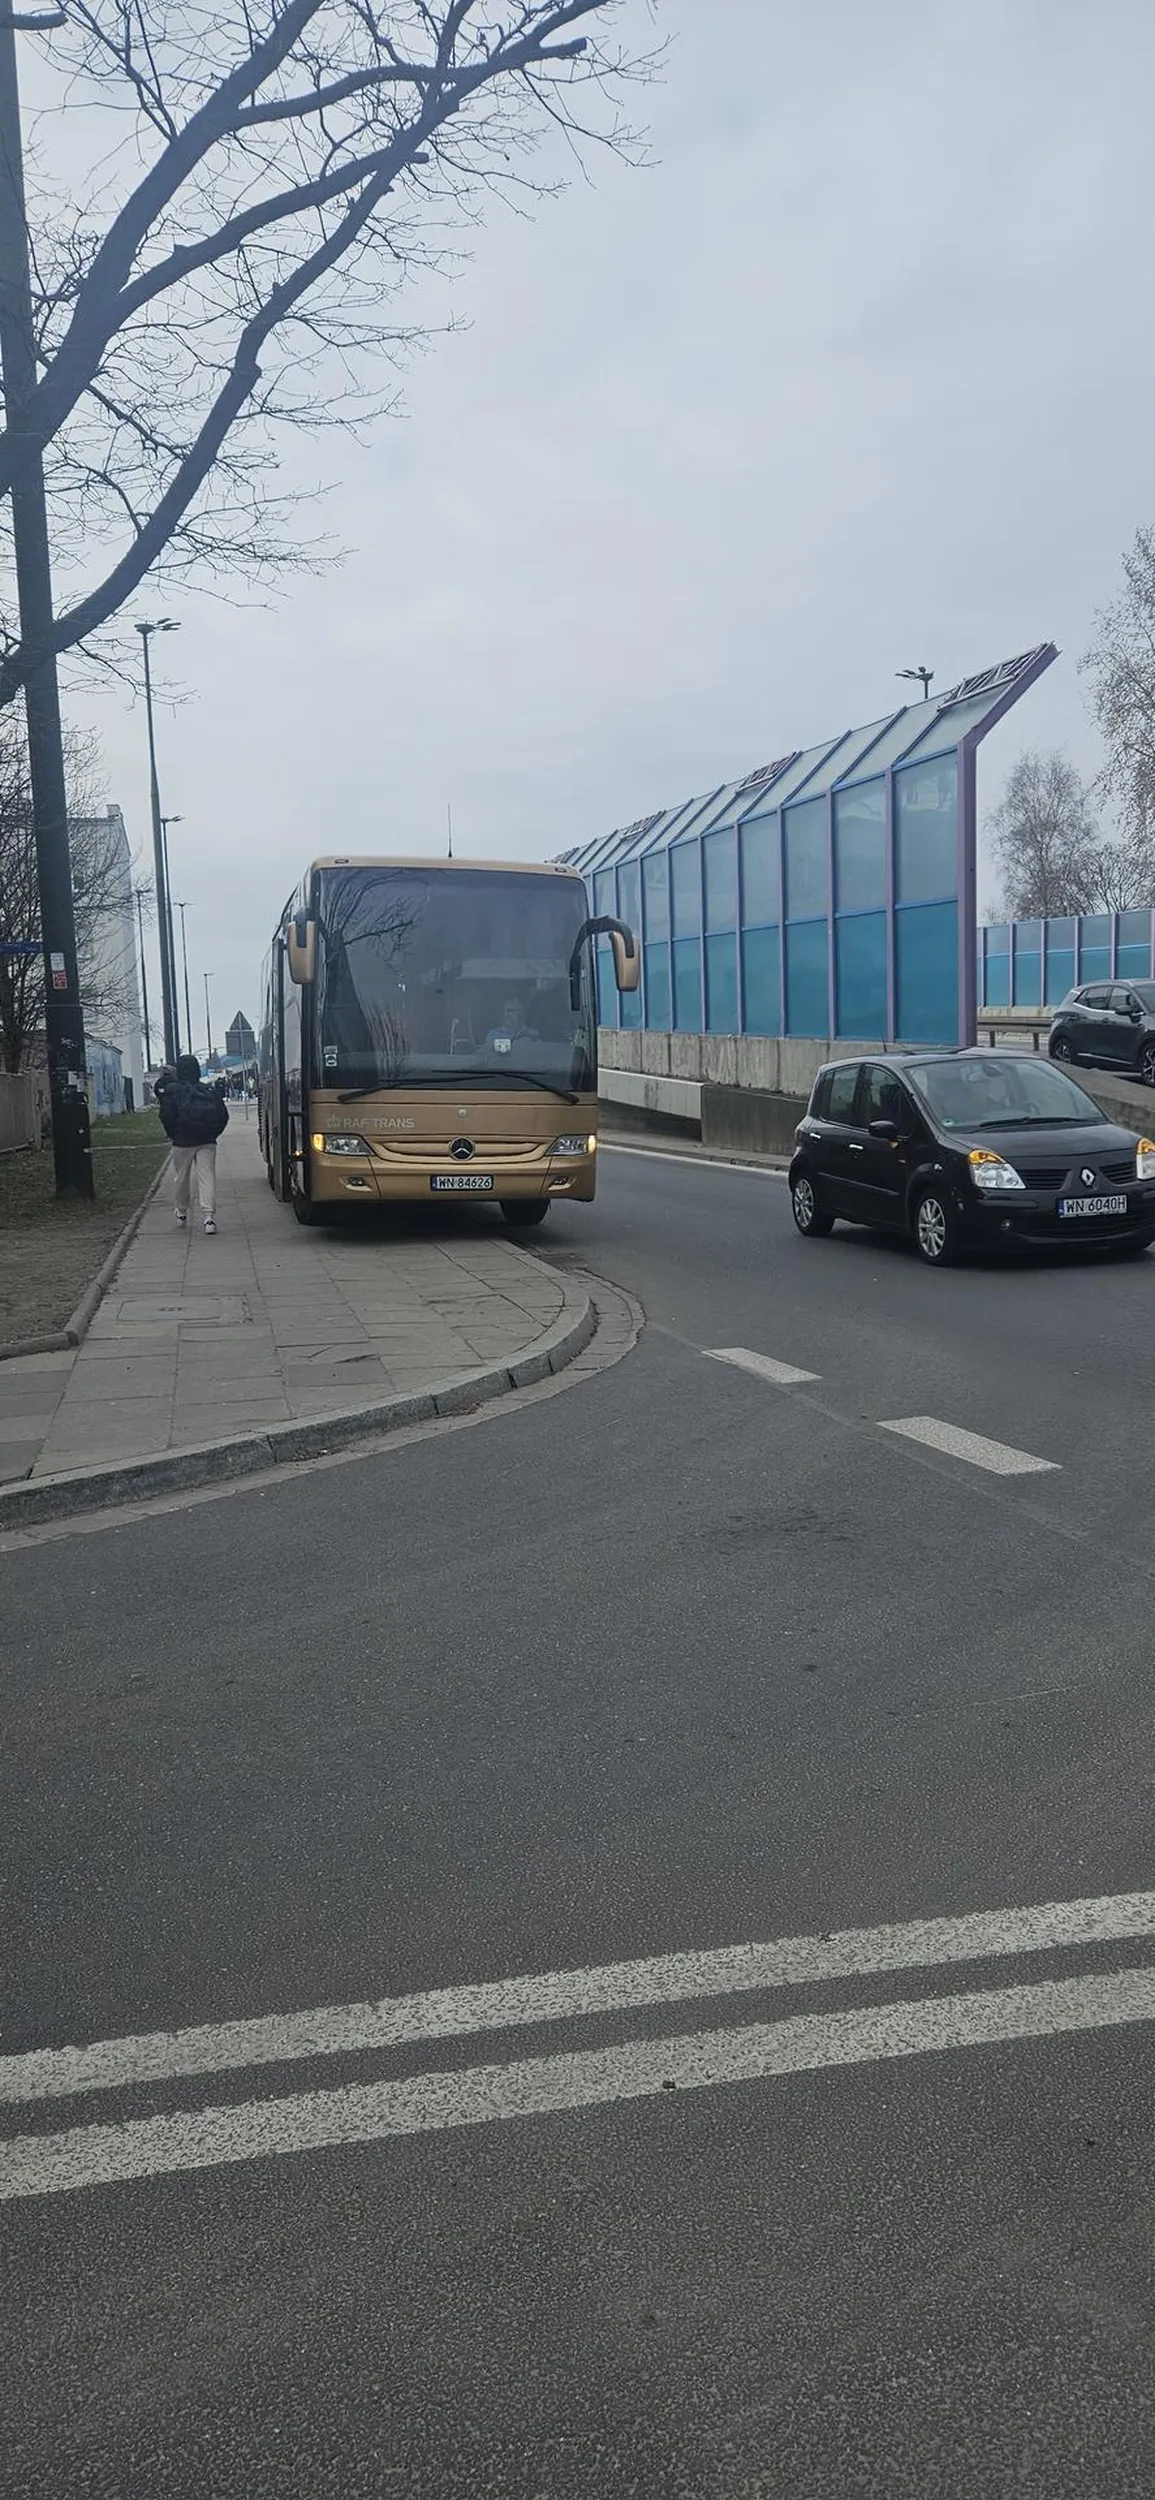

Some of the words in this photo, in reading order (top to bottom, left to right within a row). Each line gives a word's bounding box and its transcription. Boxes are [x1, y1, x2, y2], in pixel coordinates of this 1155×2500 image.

[343, 1117, 370, 1128] RAF
[372, 1117, 415, 1128] TRANS
[439, 1177, 454, 1188] WN
[457, 1177, 490, 1188] 84626
[1066, 1200, 1084, 1213] WN
[1088, 1197, 1125, 1211] 6040H
